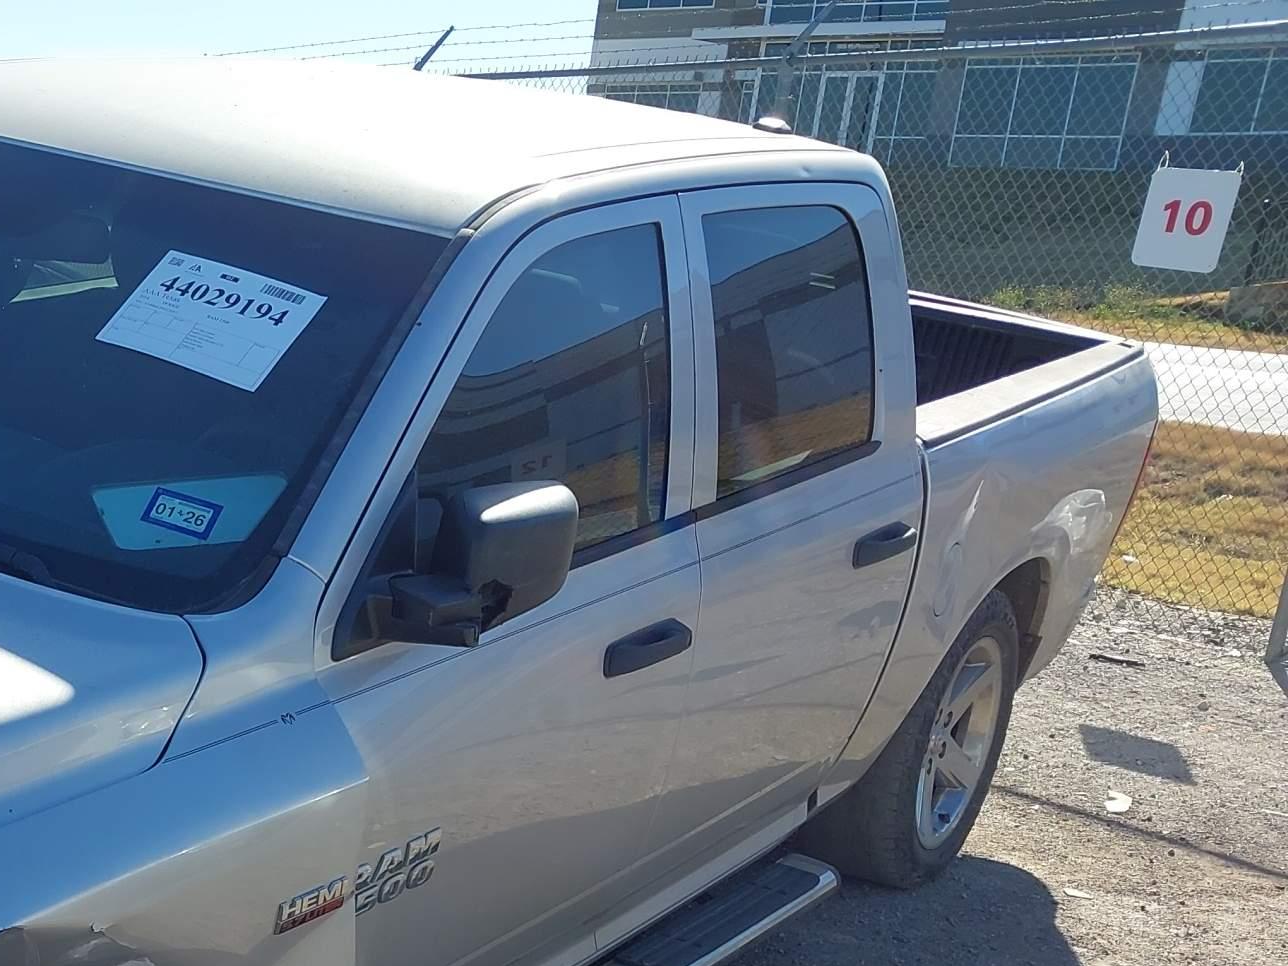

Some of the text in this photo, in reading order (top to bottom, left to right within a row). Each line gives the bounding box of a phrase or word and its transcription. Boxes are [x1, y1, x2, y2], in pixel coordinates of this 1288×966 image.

[1163, 199, 1213, 236] 10
[160, 275, 289, 327] 44029194
[155, 502, 176, 518] 01
[182, 511, 207, 527] 26
[355, 859, 435, 918] 500
